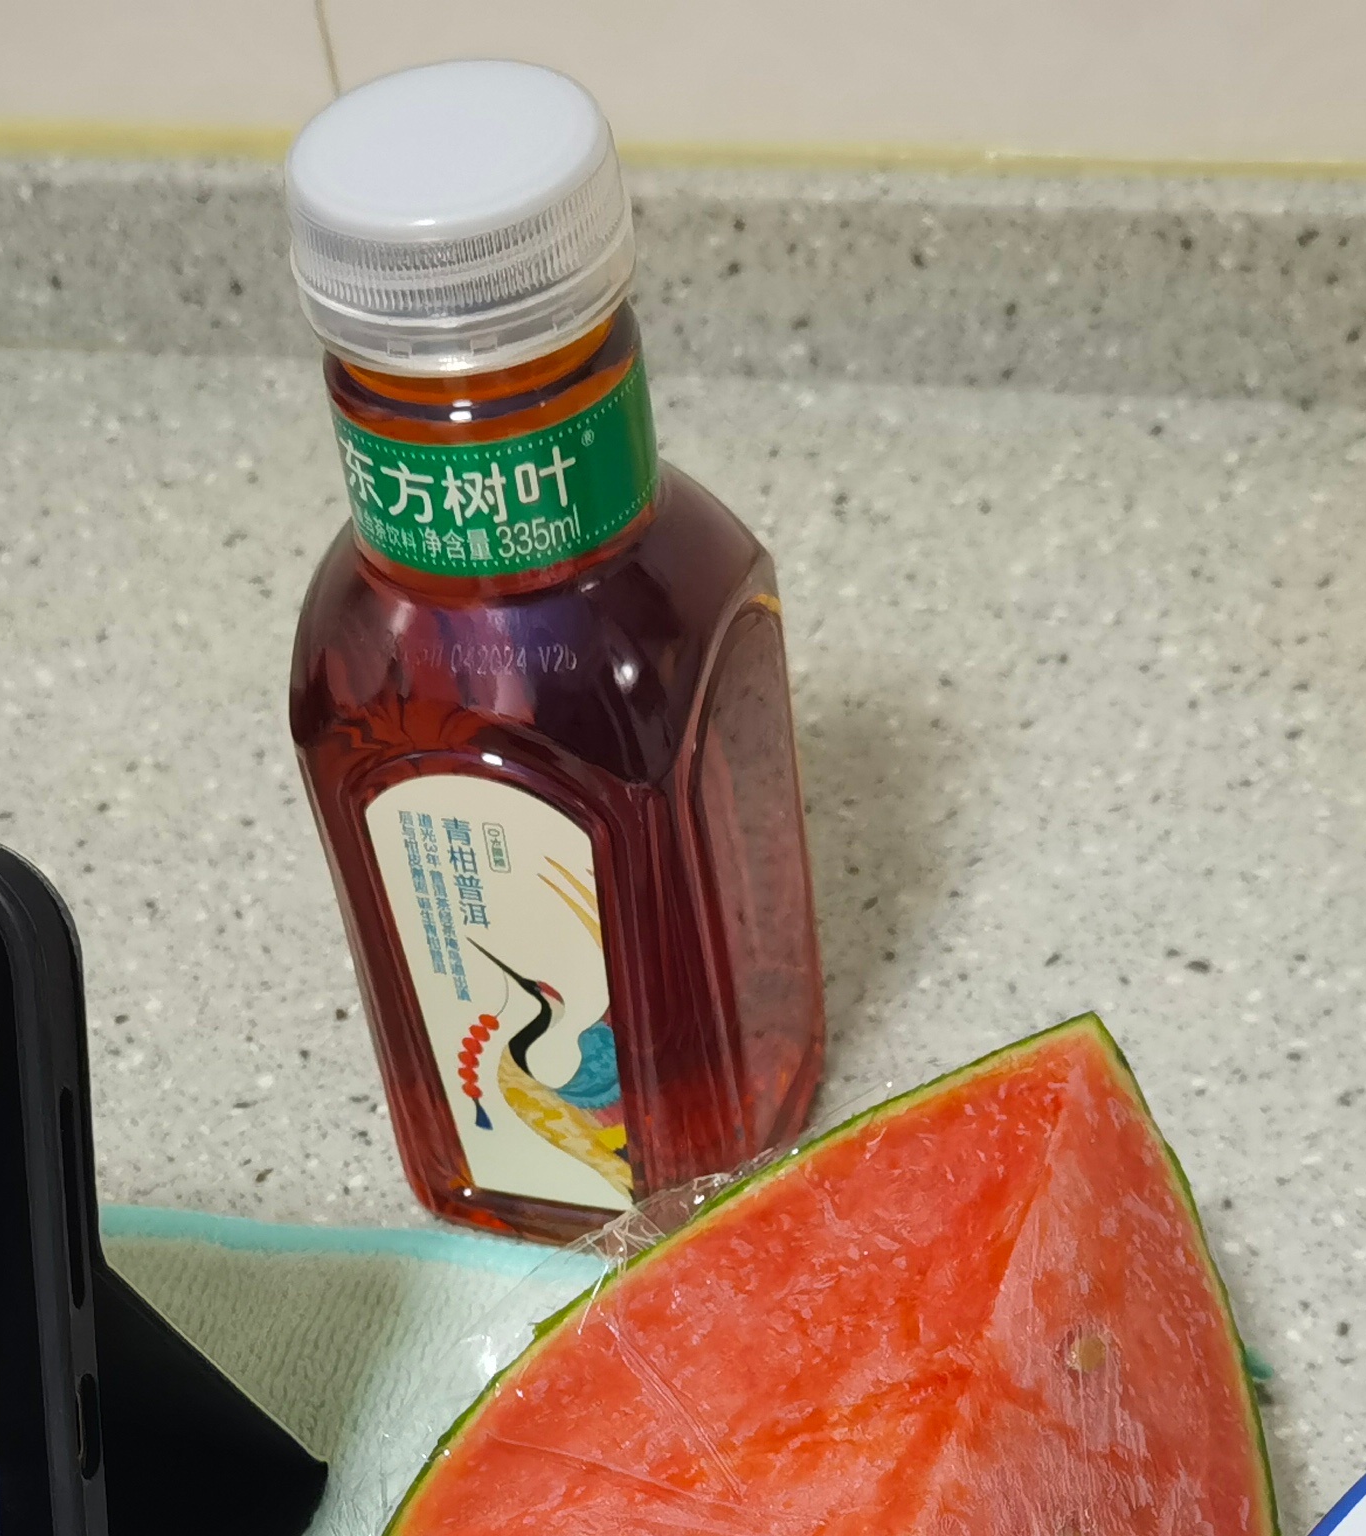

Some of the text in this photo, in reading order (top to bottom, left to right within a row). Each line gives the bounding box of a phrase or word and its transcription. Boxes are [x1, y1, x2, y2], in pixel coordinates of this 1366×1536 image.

[338, 437, 576, 527] 东方树叶
[441, 817, 491, 929] 青柑普洱
